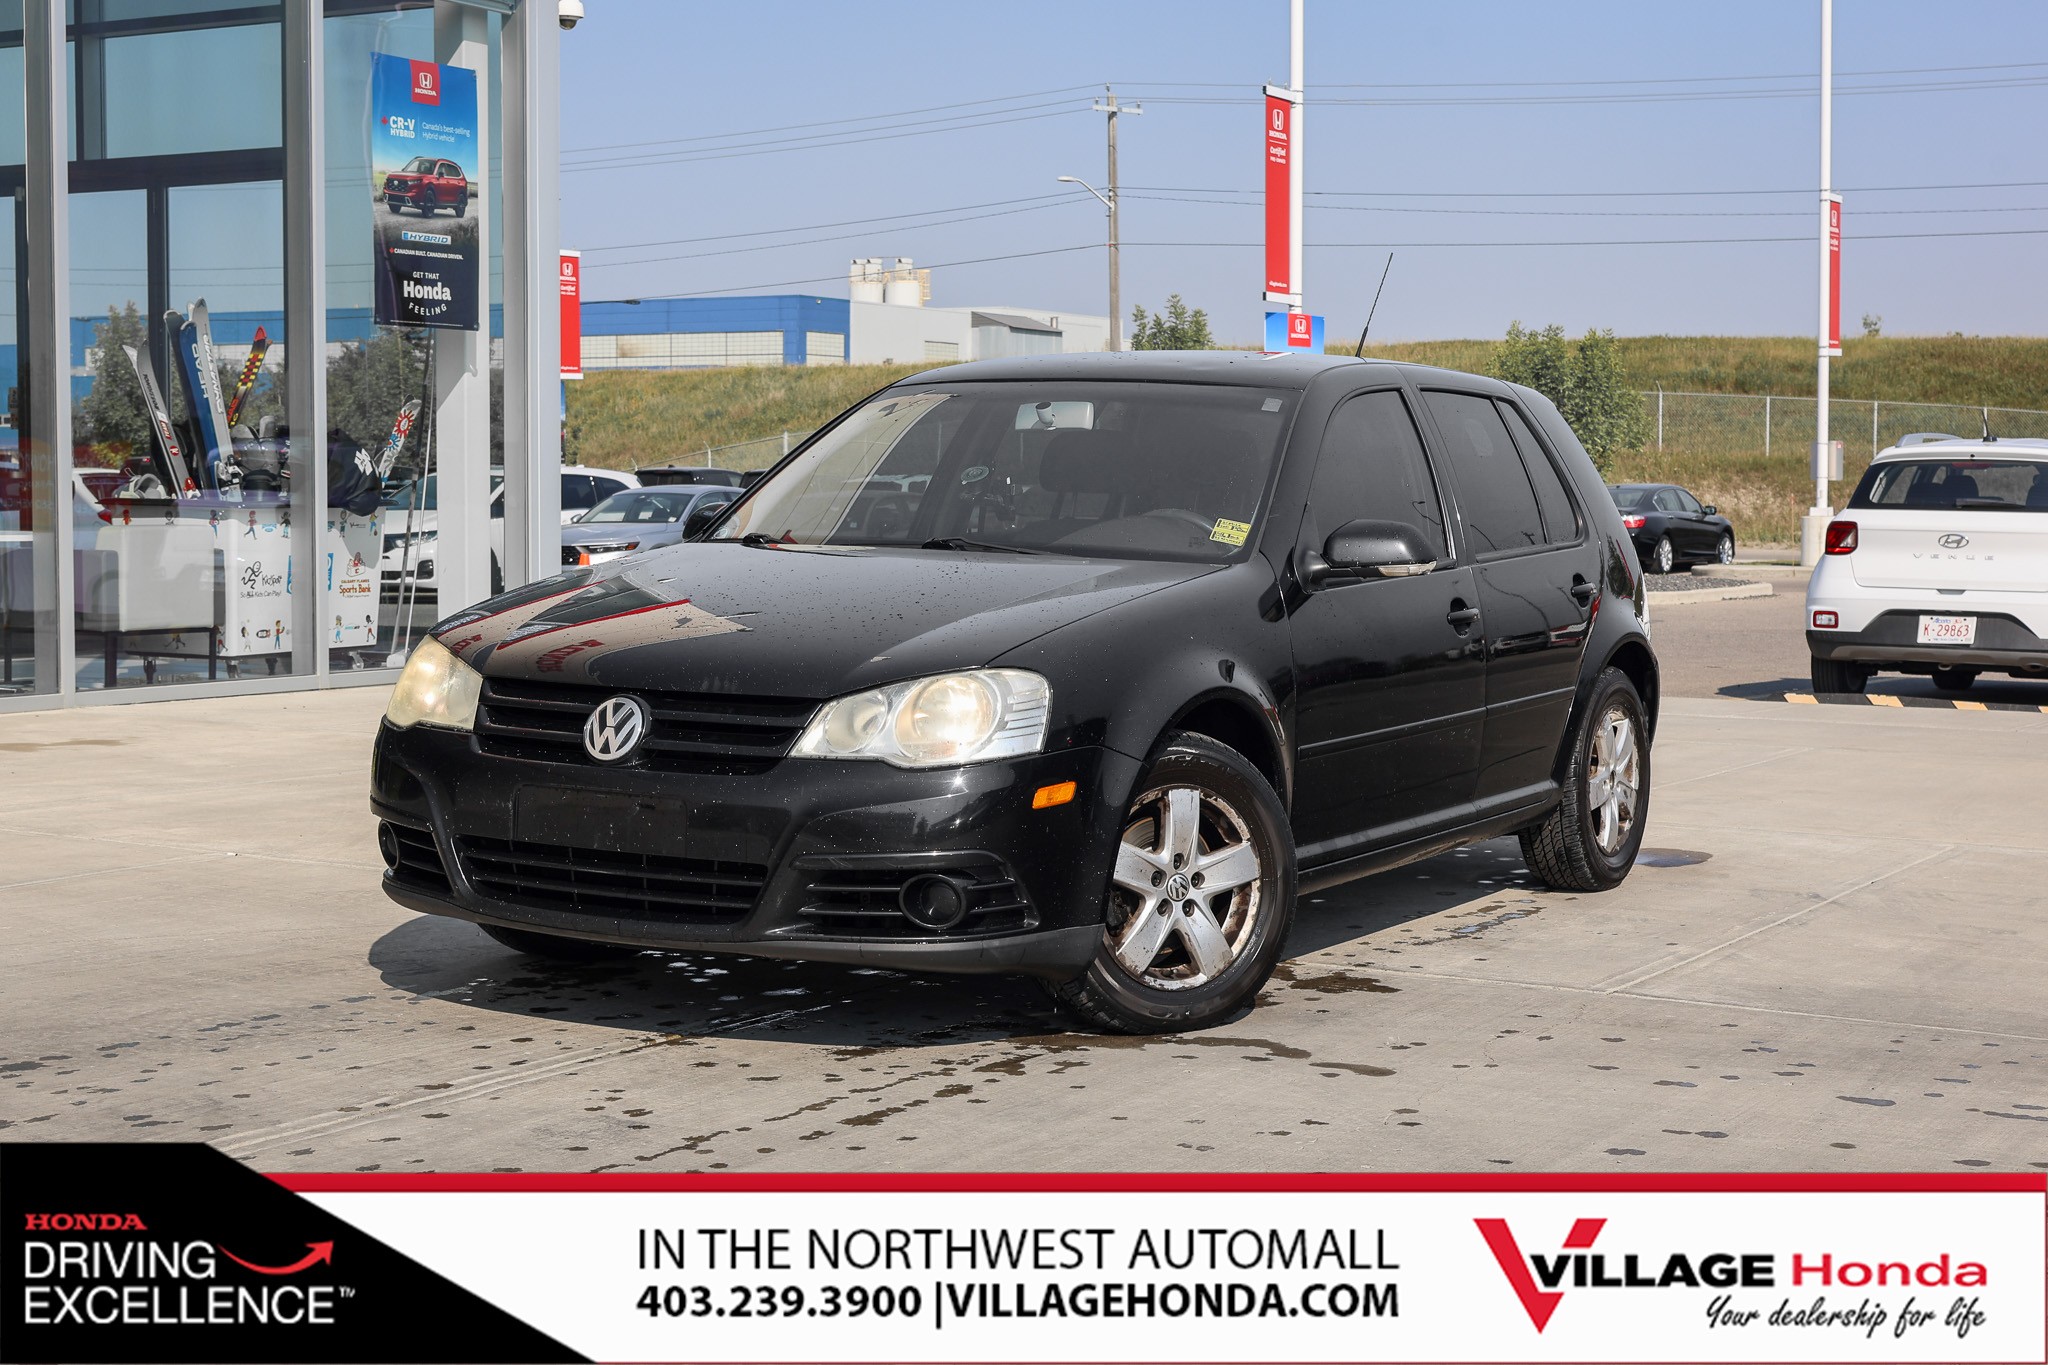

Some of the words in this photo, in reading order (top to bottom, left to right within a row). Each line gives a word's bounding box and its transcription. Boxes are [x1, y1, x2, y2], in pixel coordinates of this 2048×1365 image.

[414, 87, 437, 97] HONDA
[389, 115, 416, 131] CR-V
[390, 127, 416, 139] HYBRID
[421, 121, 443, 132] Canada's
[443, 124, 471, 138] best-selling
[422, 131, 438, 141] Hybrid
[393, 247, 416, 256] CANADIAN
[426, 251, 448, 259] CANADIAN
[412, 271, 424, 279] GET
[424, 272, 440, 280] THAT
[403, 280, 452, 301] Honda
[408, 301, 448, 316] FEELING
[1290, 332, 1310, 340] HONDA
[1912, 552, 1995, 561] VENUE
[339, 584, 357, 597] Sports
[358, 583, 372, 593] Bank
